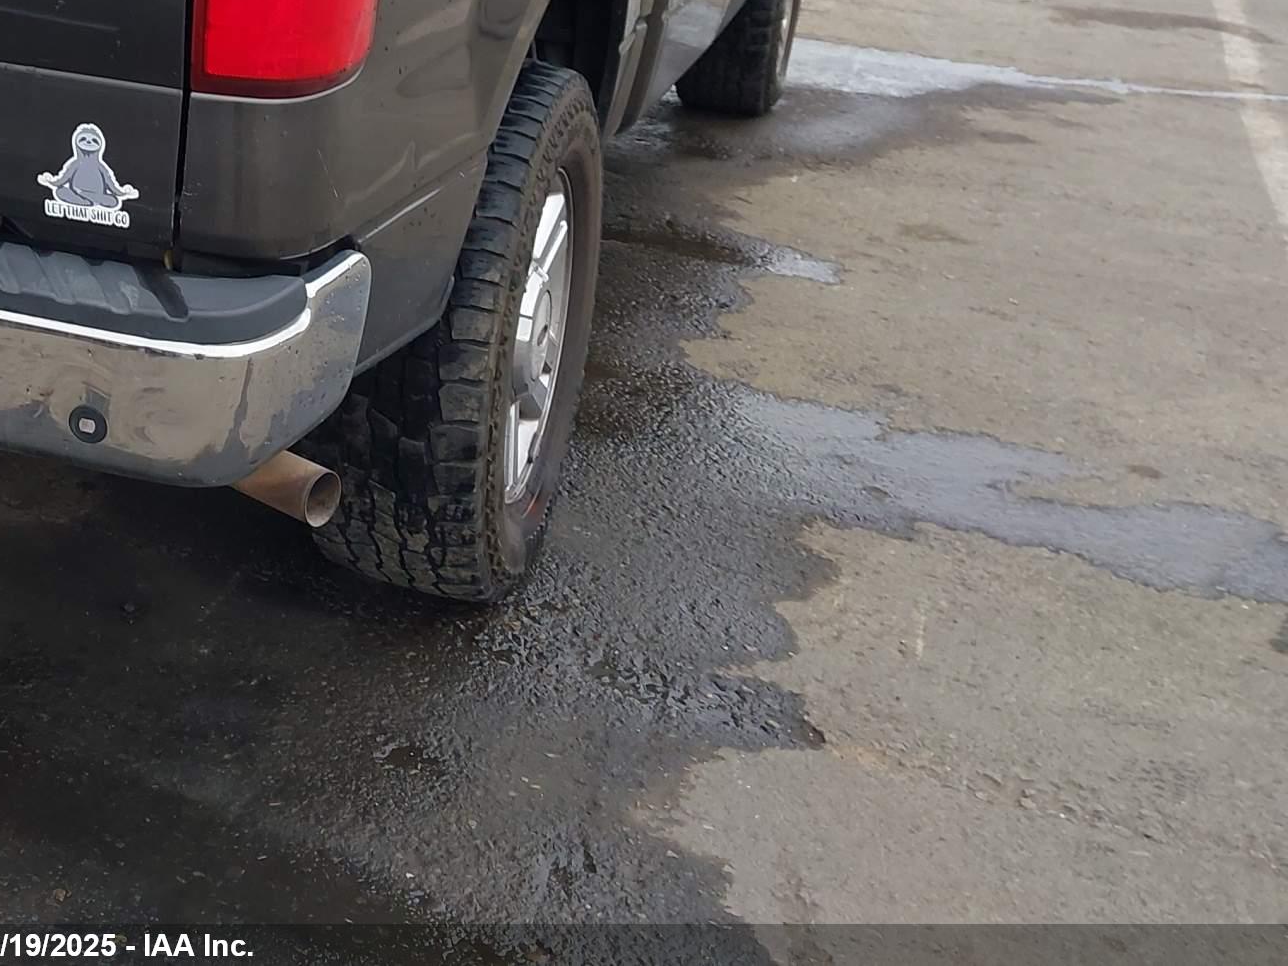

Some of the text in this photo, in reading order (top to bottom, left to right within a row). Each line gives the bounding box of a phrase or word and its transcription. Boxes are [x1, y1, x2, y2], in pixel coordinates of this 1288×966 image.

[46, 200, 128, 225] LET THAT SHIT GO
